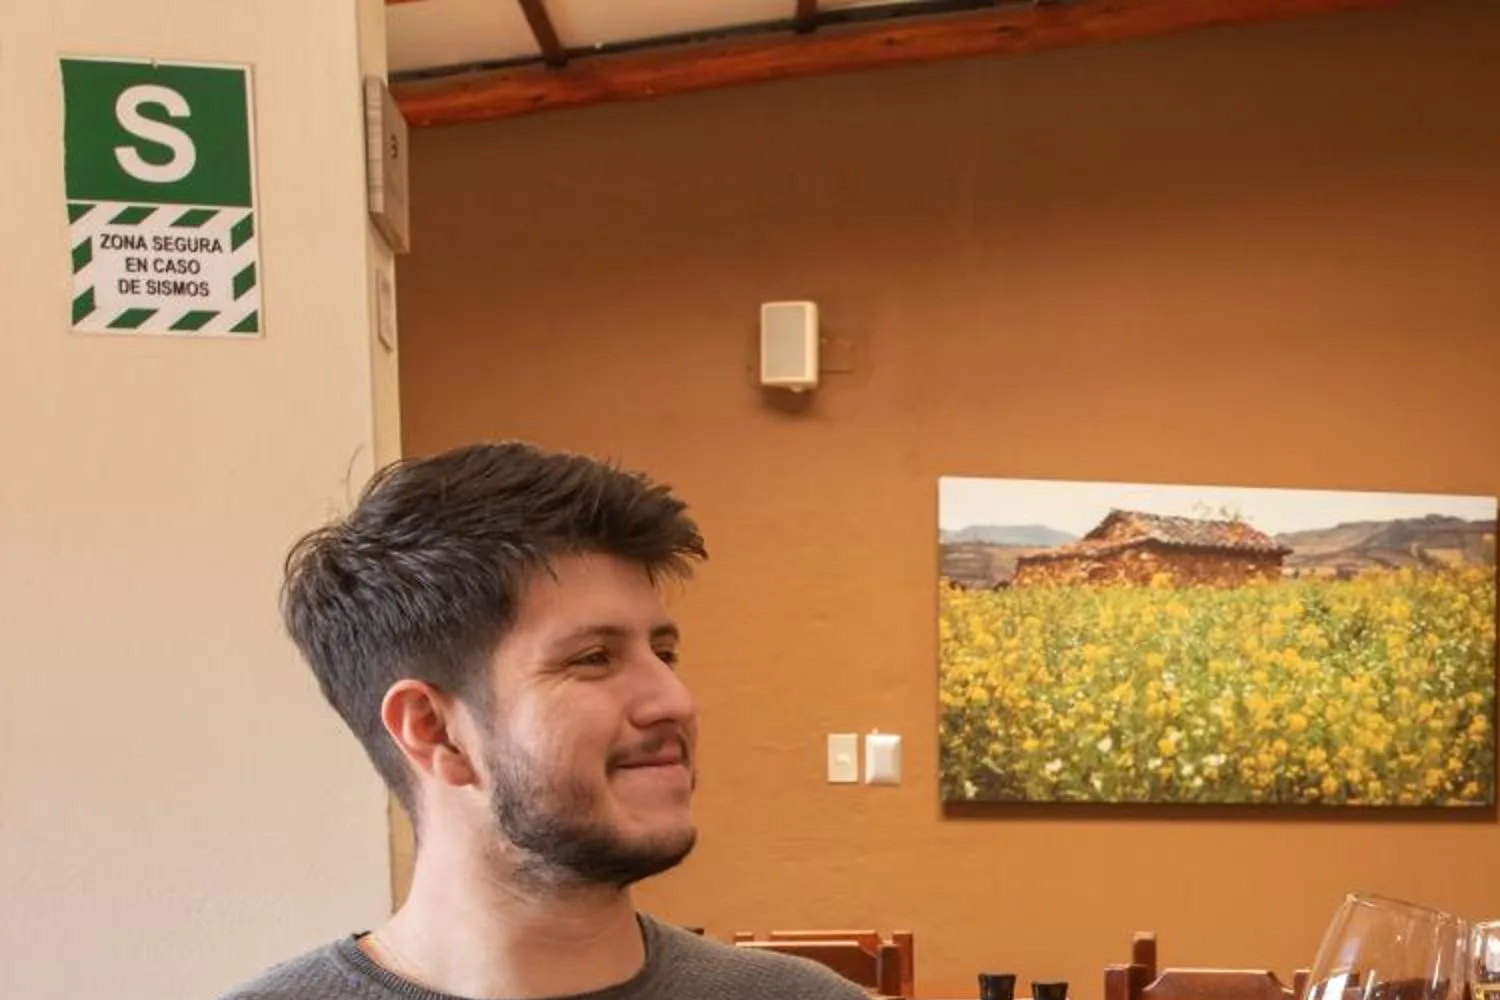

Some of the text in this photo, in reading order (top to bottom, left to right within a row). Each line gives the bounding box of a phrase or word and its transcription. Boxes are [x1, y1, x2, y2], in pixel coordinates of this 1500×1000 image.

[114, 84, 196, 183] S
[100, 233, 223, 253] ZONA SEGURA
[125, 257, 201, 275] EN CASO
[118, 278, 209, 297] DE SISMOS
